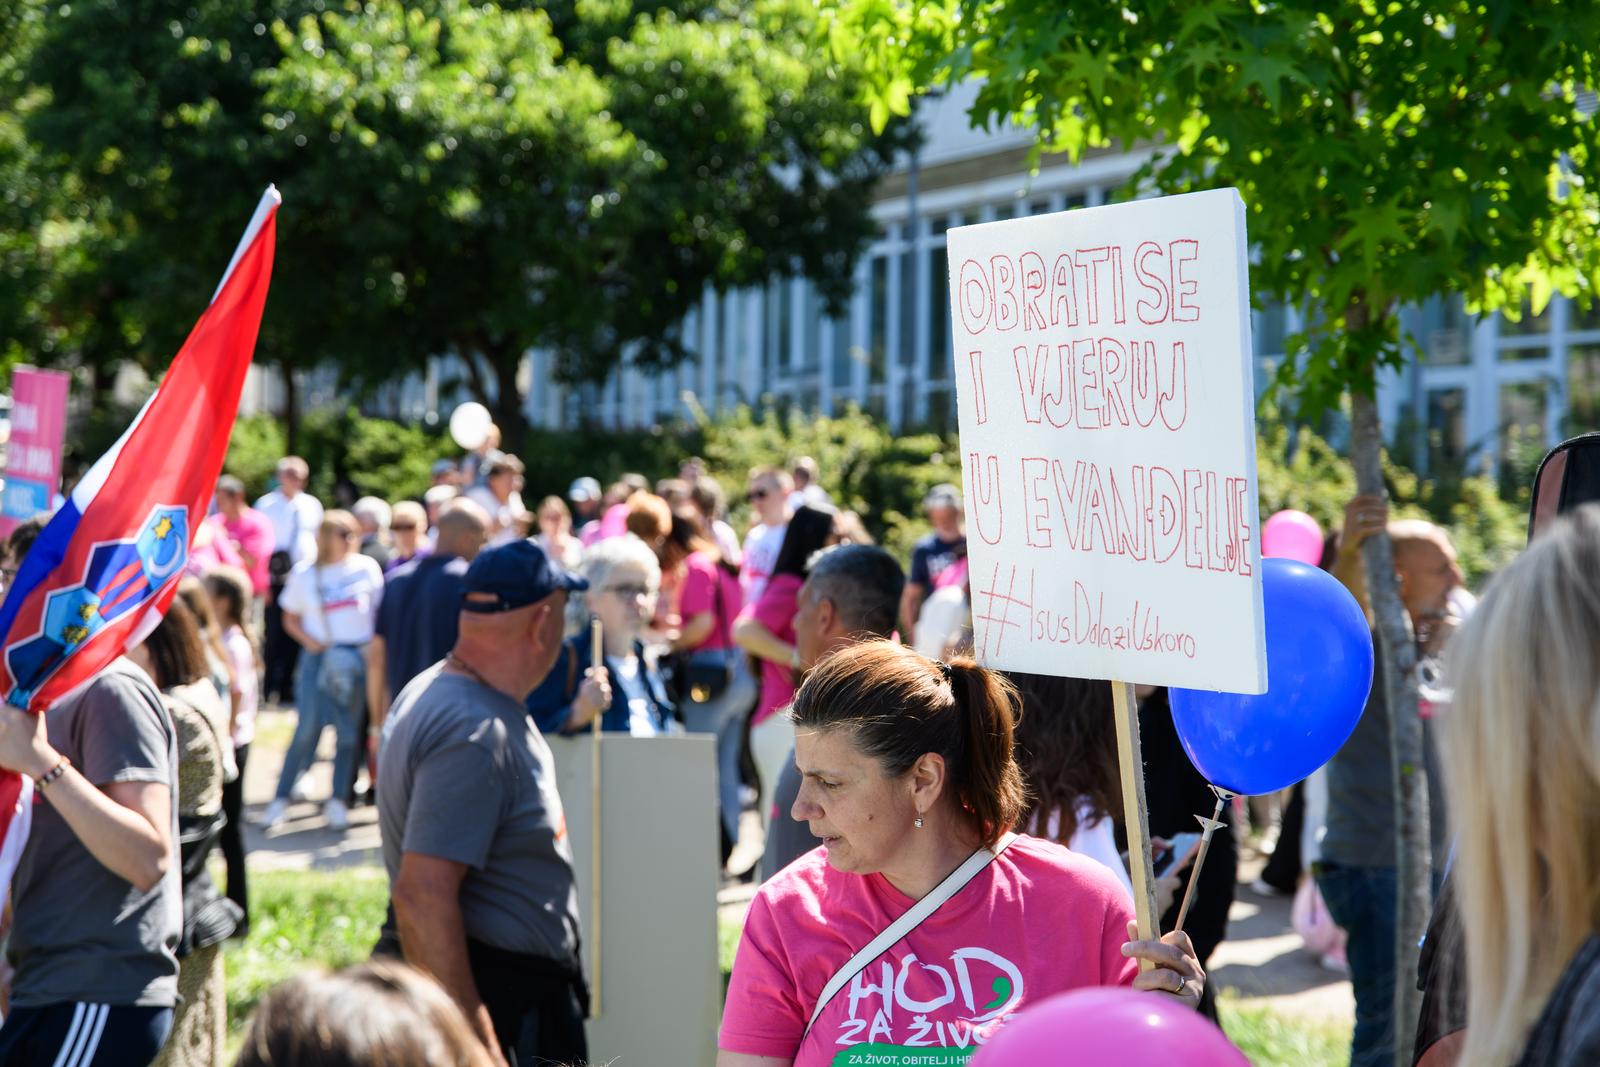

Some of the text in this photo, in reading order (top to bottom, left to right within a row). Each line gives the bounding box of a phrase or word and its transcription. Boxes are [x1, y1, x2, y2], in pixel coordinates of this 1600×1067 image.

[969, 337, 1187, 431] I VJERUJ
[970, 453, 1252, 577] U EVANĐELJE
[848, 947, 1024, 1023] HOD
[835, 1008, 1012, 1050] ZA ŽIVO
[849, 1055, 864, 1065] ZA
[865, 1053, 900, 1067] ŽIVOT,
[902, 1055, 948, 1066] OBITELJ
[951, 1056, 955, 1066] I
